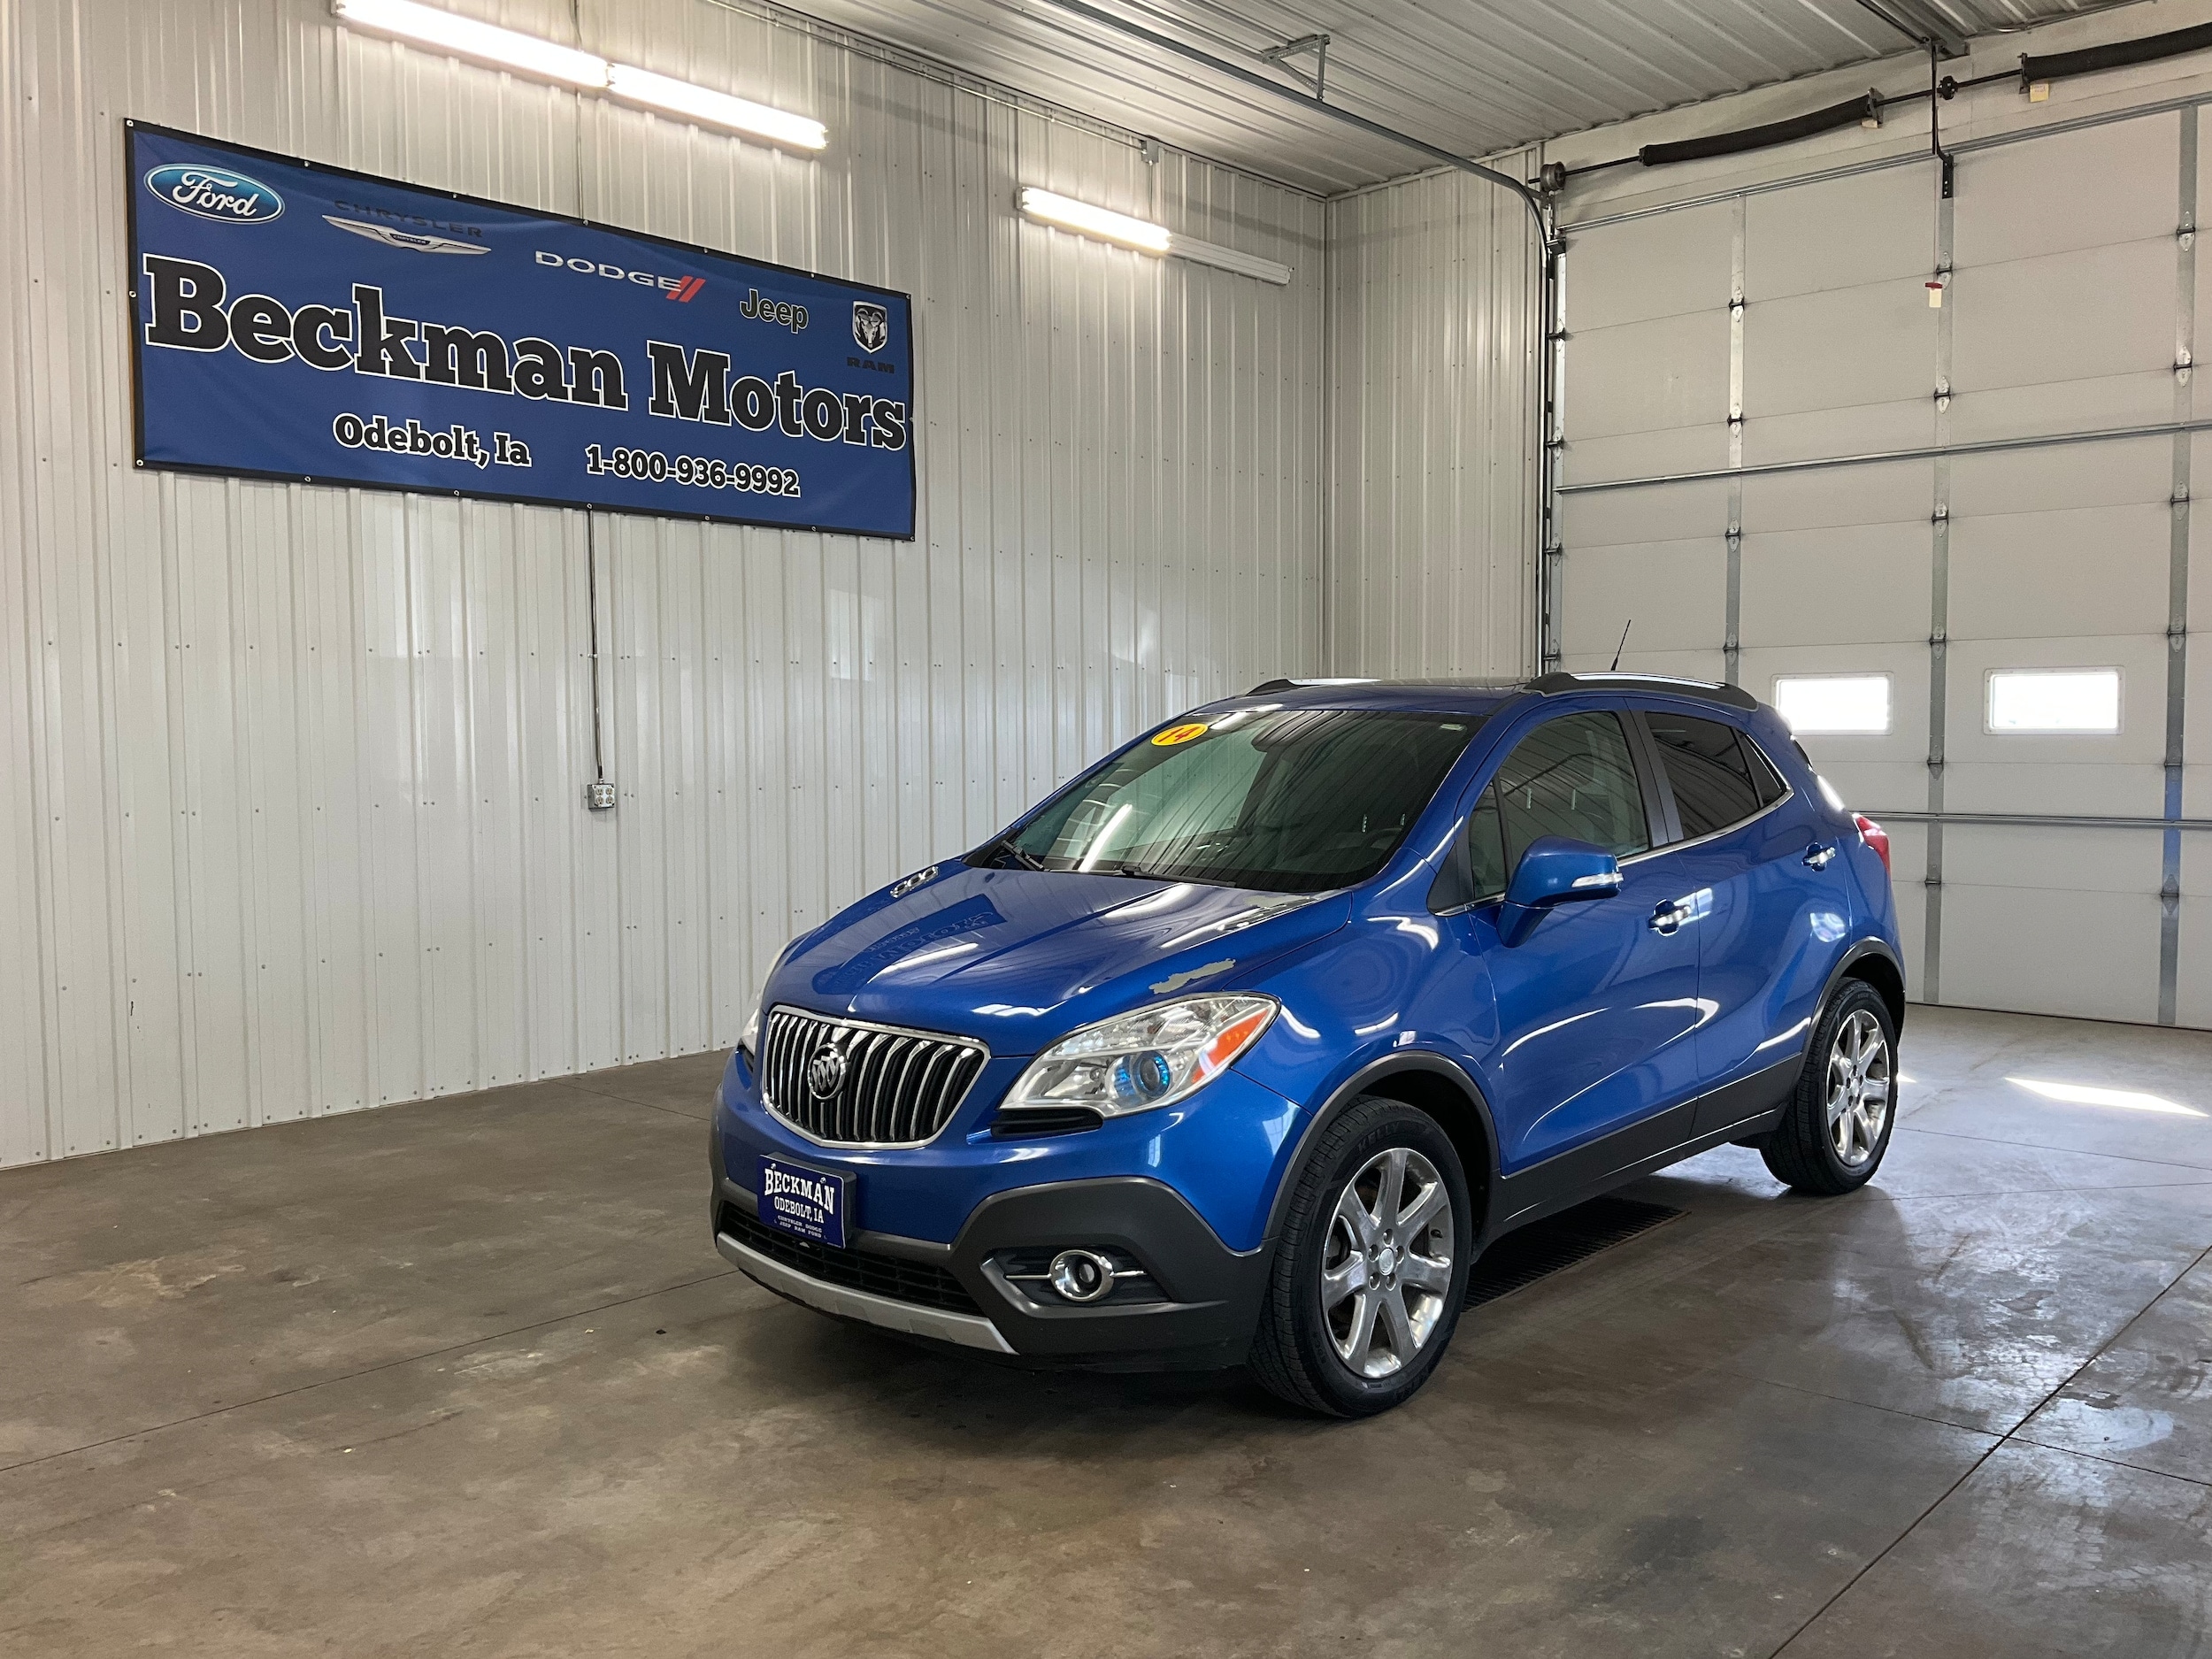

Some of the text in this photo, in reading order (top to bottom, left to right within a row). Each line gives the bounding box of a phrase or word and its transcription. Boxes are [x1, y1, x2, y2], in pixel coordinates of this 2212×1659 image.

[173, 169, 258, 218] Ford
[334, 200, 483, 238] CHRYSLER
[535, 250, 683, 292] DODGE
[740, 288, 809, 334] Jeep
[142, 253, 907, 451] Beckman Motors
[847, 357, 895, 374] RAM
[333, 412, 533, 470] Odebolt, Ia
[585, 443, 802, 497] 1-800-936-9992
[764, 1168, 834, 1215] BECKMAN
[774, 1196, 825, 1224] ODEBOLT, IA
